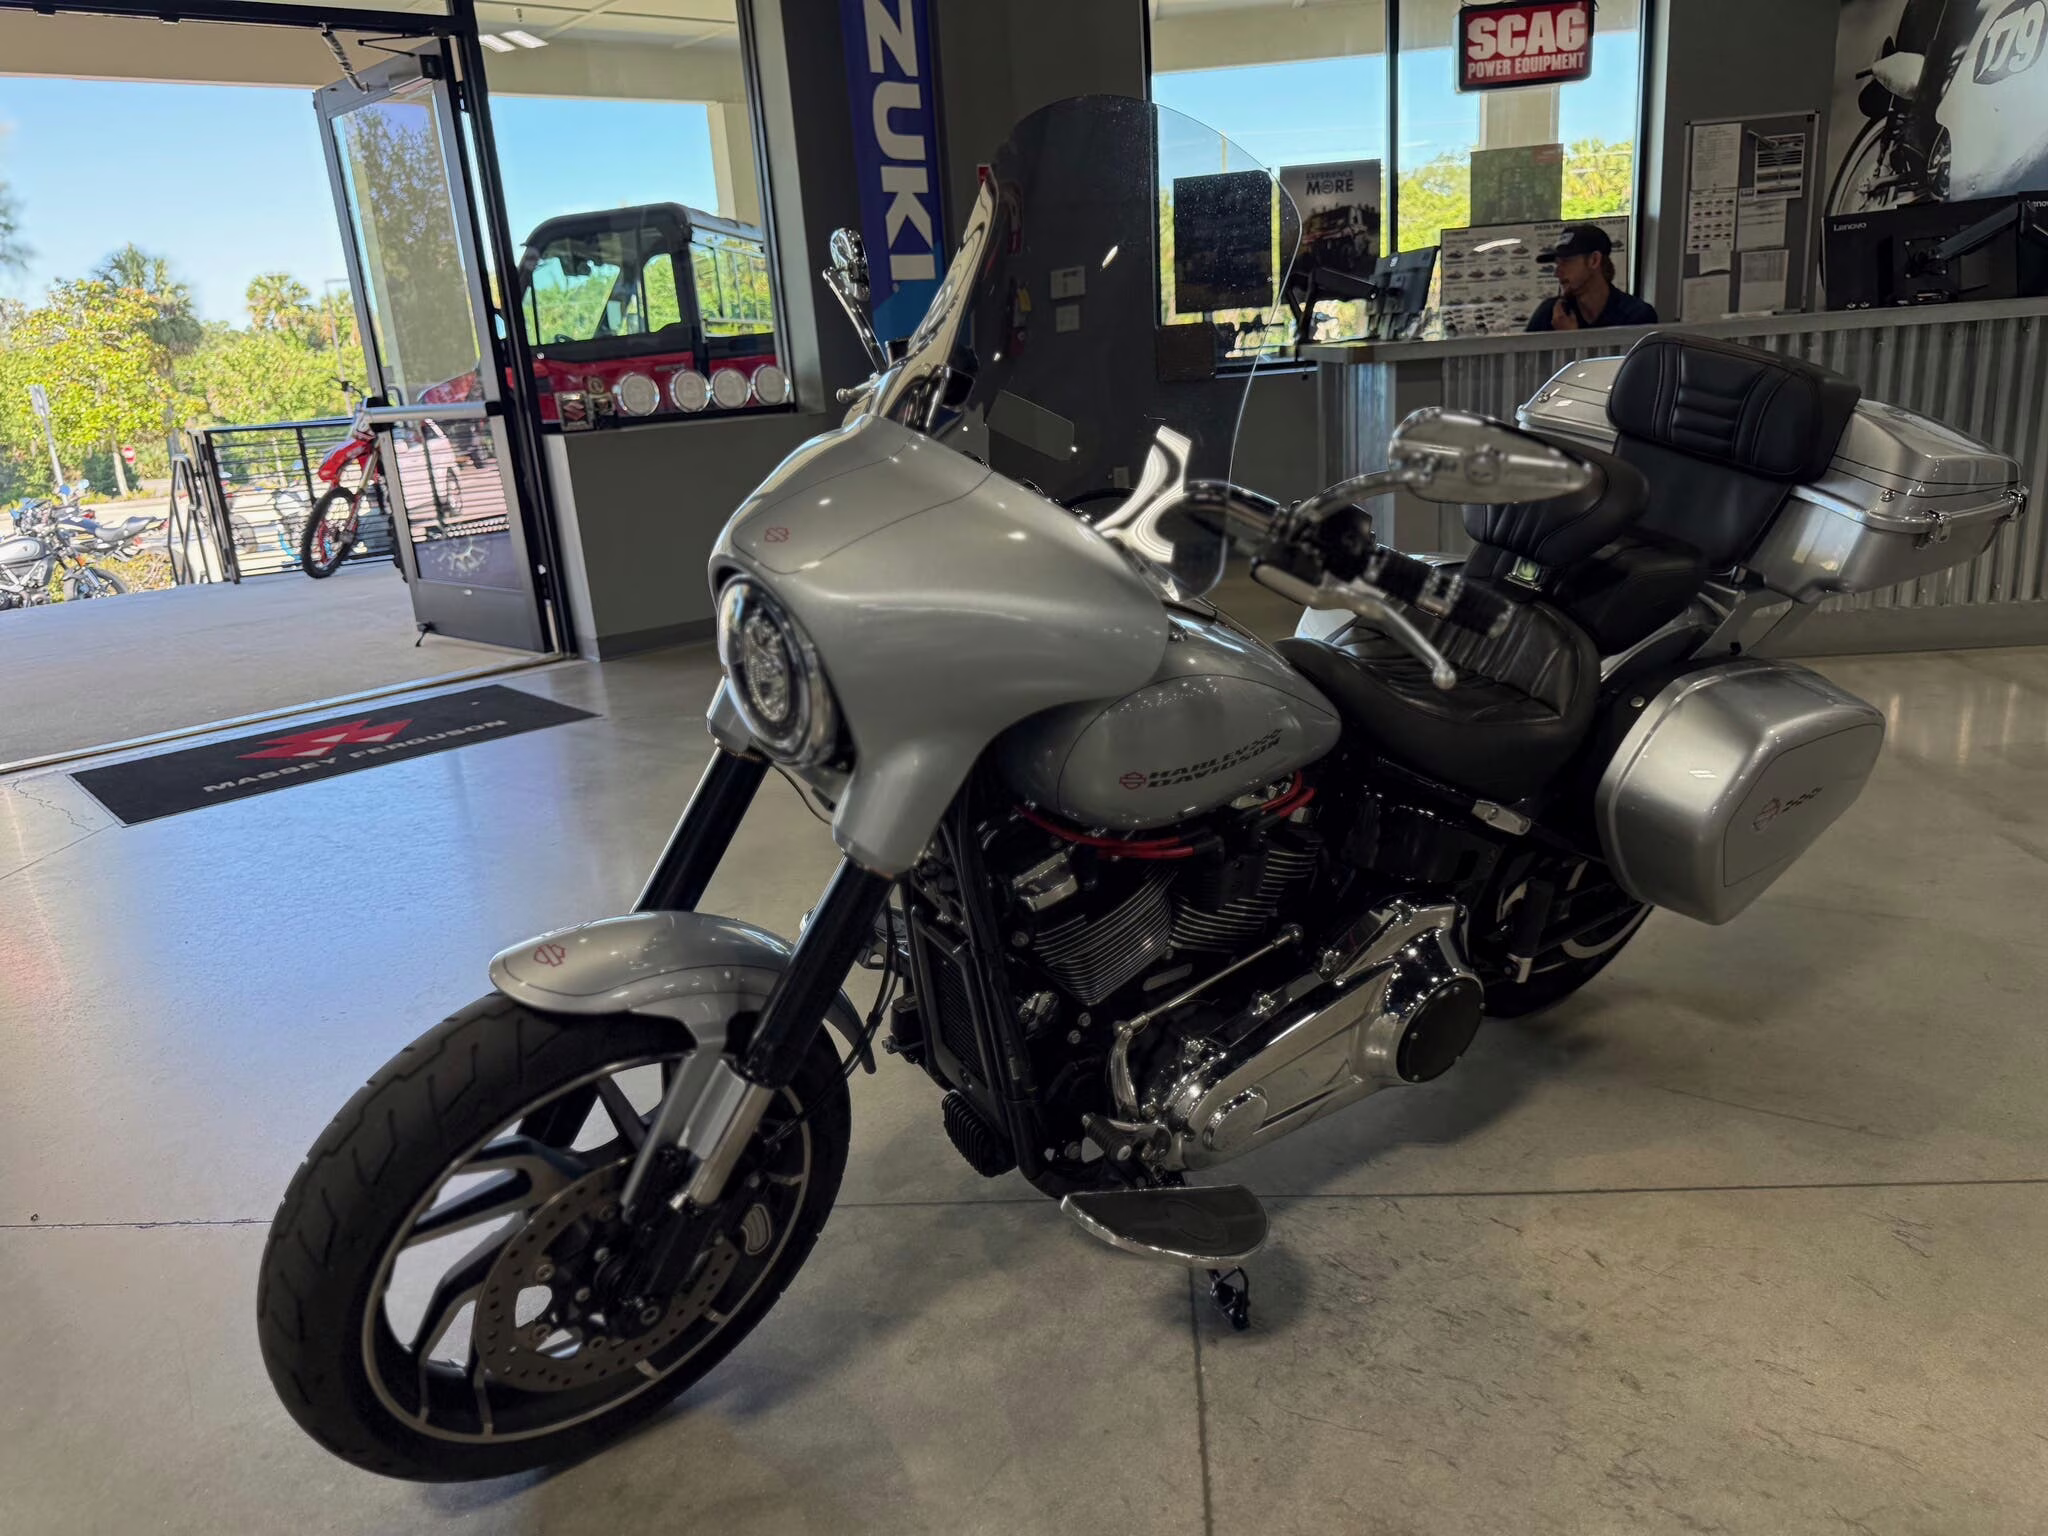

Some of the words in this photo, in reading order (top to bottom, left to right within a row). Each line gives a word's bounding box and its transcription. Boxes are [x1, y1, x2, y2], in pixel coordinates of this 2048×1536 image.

[1468, 8, 1586, 60] SCAG
[1977, 4, 2044, 79] 179
[1468, 59, 1511, 79] POWER
[1515, 52, 1585, 74] EQUIPMENT
[1306, 178, 1354, 195] MORE
[1833, 222, 1867, 232] Lenovo
[203, 756, 338, 793] MASSEY
[349, 719, 509, 758] FERGUSON
[1147, 737, 1281, 788] DAVIDSON
